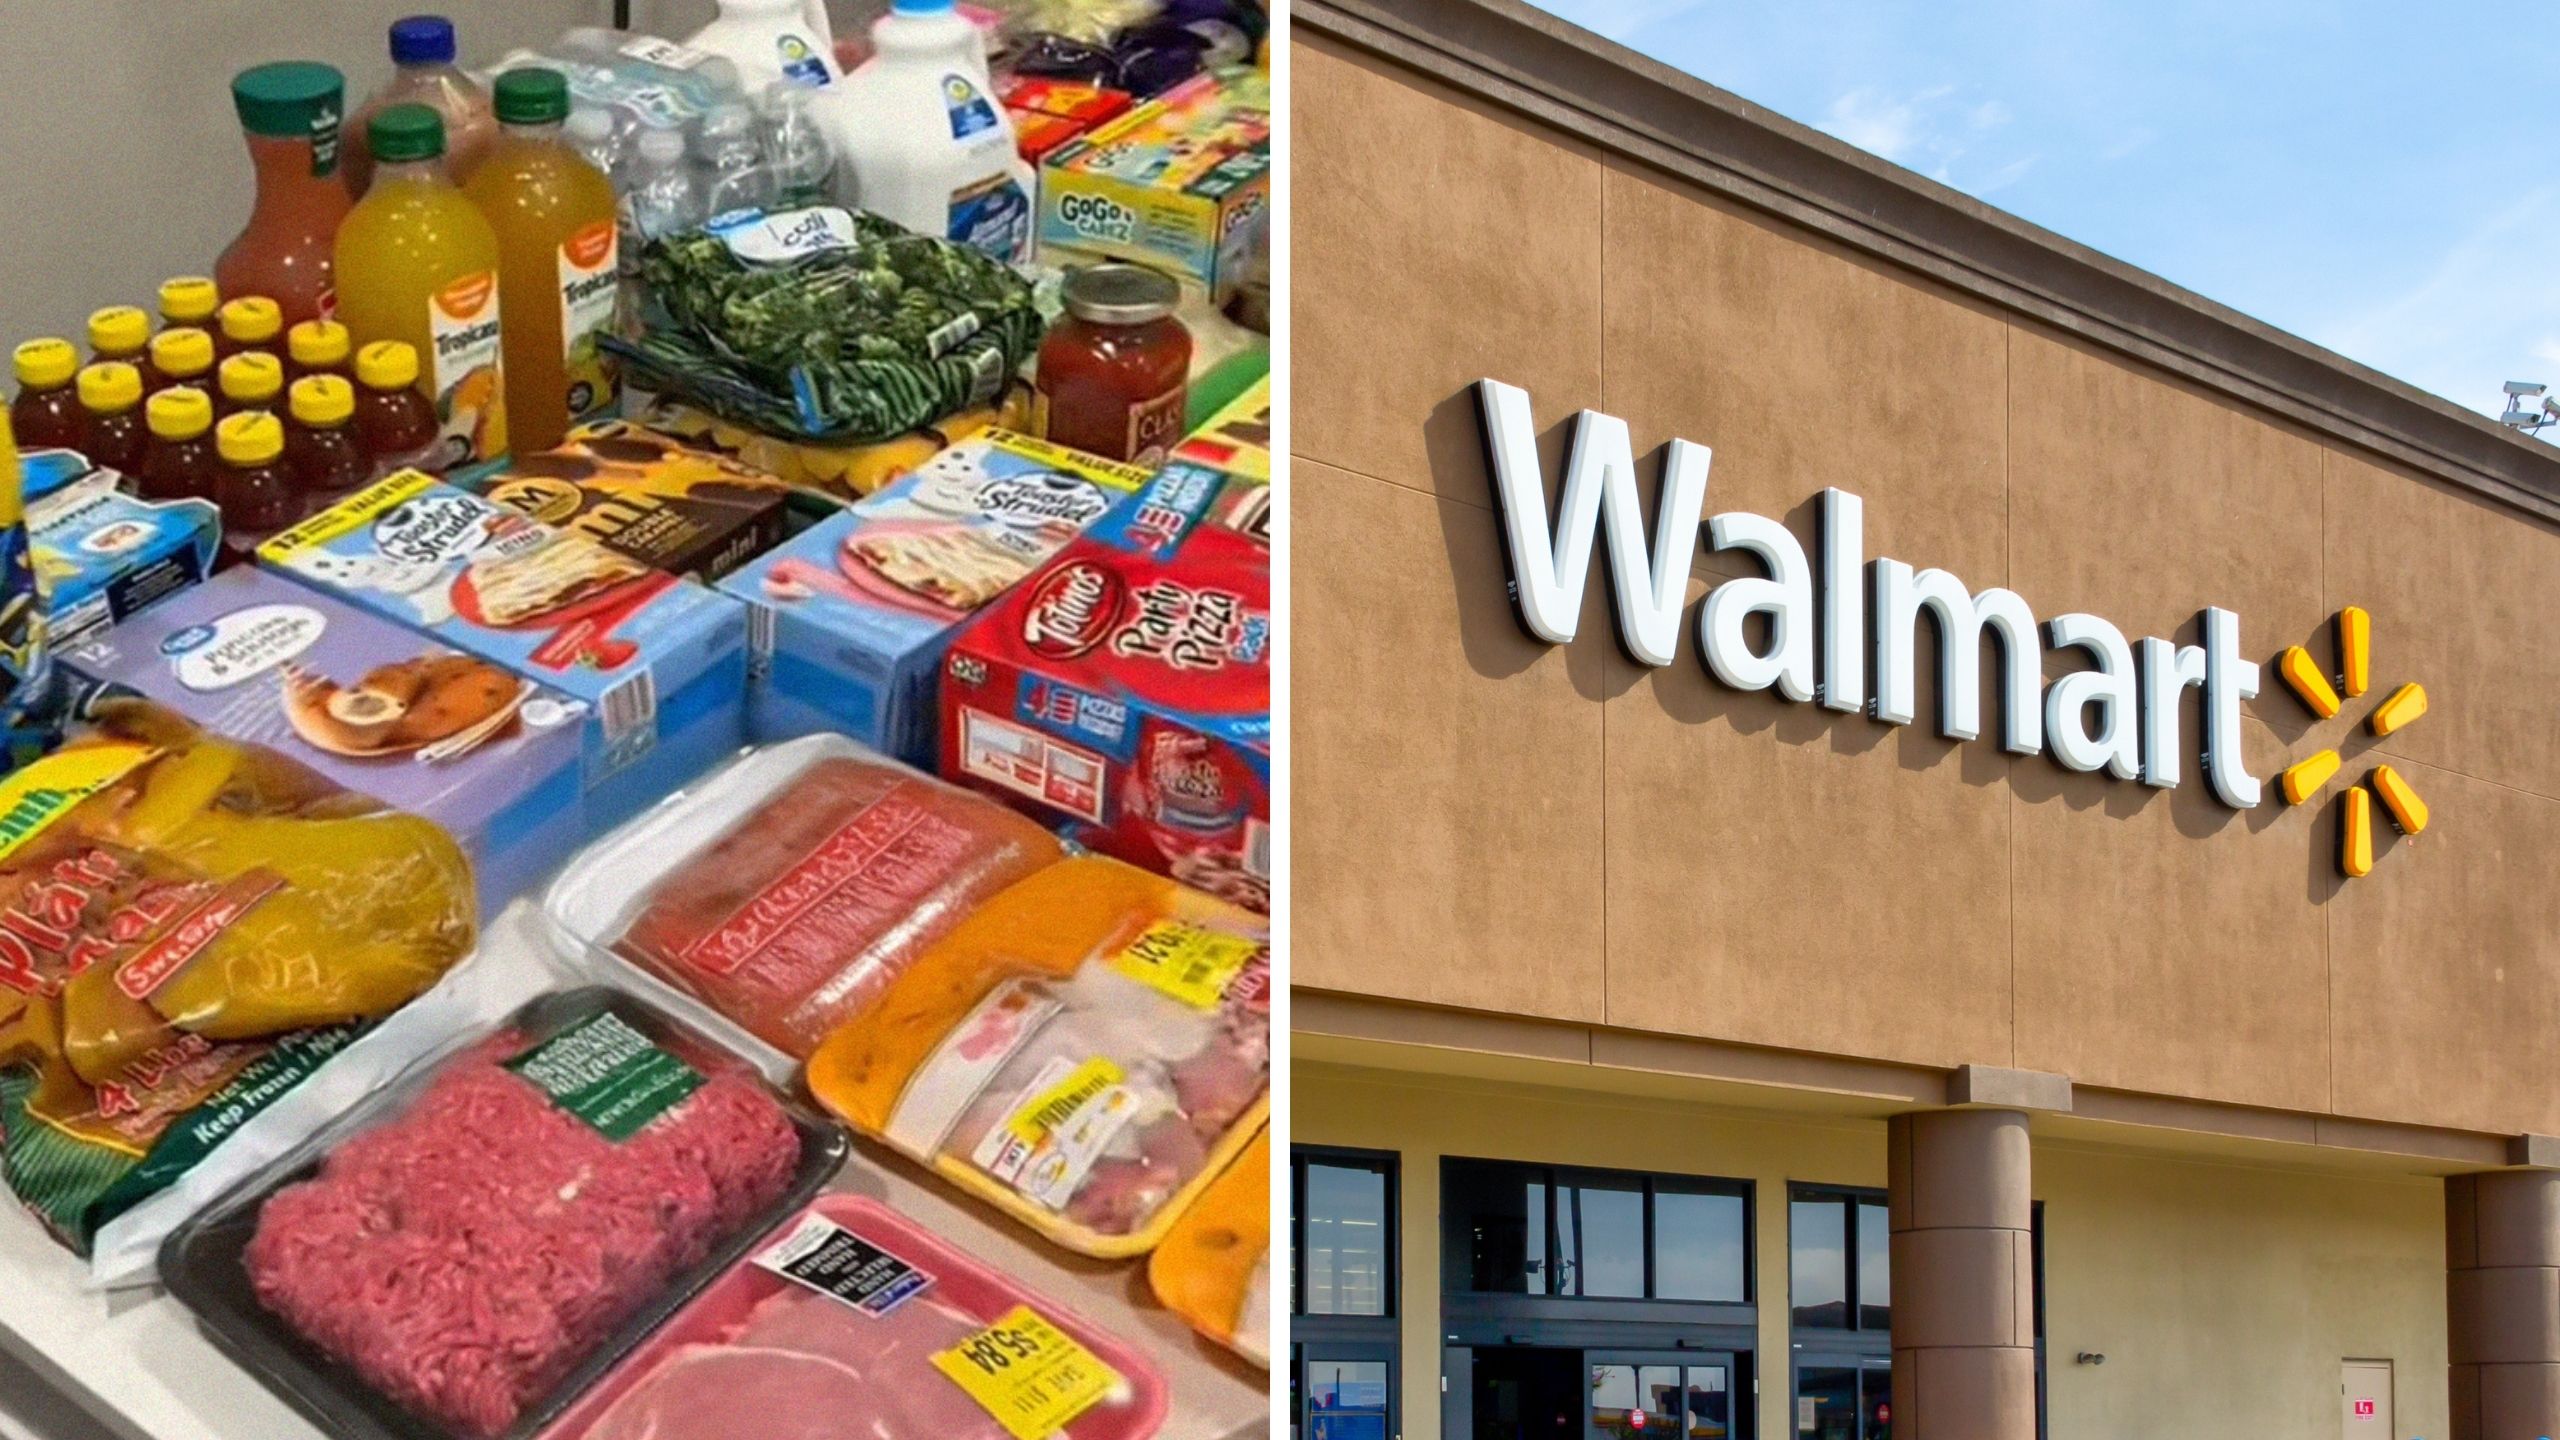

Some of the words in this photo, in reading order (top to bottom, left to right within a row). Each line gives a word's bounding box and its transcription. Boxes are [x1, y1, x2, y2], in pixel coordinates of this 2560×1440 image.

[1061, 195, 1121, 223] GoGo
[403, 498, 490, 564] Strudel
[980, 489, 1102, 524] Strudel
[1023, 565, 1104, 647] Totino's
[1113, 580, 1195, 655] Party
[1170, 589, 1236, 668] Pizza
[1478, 376, 2262, 810] Walmart
[192, 1103, 244, 1146] Keep
[241, 1066, 302, 1108] Frozen
[960, 1328, 1041, 1377] $5.84
